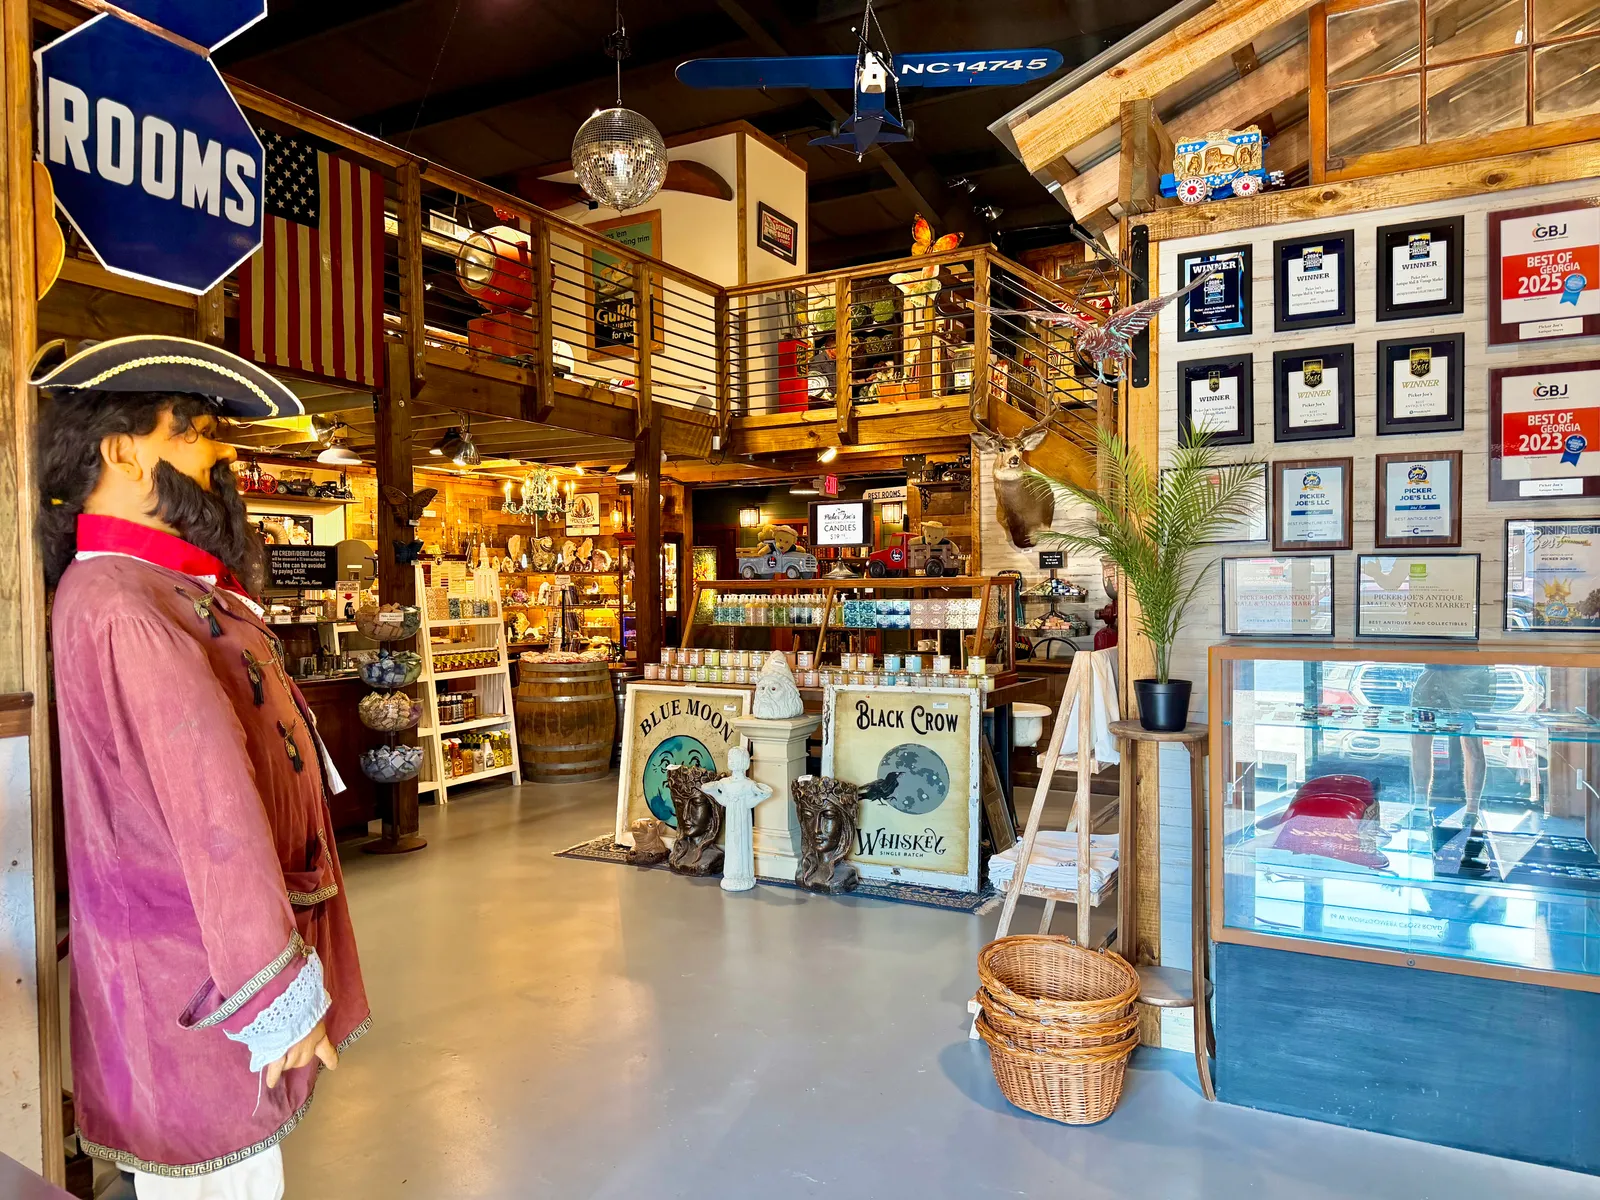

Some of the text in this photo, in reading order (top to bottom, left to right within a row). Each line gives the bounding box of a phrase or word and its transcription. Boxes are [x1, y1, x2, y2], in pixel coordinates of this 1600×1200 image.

[901, 58, 1048, 75] NC14745
[48, 77, 257, 227] ROOMS
[1533, 223, 1567, 239] GBJ
[637, 235, 650, 243] trim
[1402, 261, 1437, 270] WINNER
[1527, 252, 1573, 268] BEST OF
[1192, 261, 1236, 274] WINNER
[1540, 262, 1580, 274] GEORGIA
[1296, 273, 1330, 282] WINNER
[1518, 273, 1563, 294] 2025
[612, 330, 622, 339] for
[1402, 379, 1440, 389] WINNER
[1533, 383, 1568, 398] GBJ
[1199, 394, 1230, 402] WINNER
[1297, 389, 1331, 399] WINNER
[1527, 412, 1573, 426] BEST OF
[1540, 423, 1581, 433] GEORGIA
[1519, 433, 1563, 452] 2023
[867, 489, 901, 500] REST ROOMS
[824, 524, 857, 532] CANDLES
[1522, 530, 1569, 554] Best
[1435, 601, 1471, 609] MARKET
[639, 698, 734, 743] BLUE MOON
[855, 700, 958, 735] BLACK CROW
[854, 827, 947, 856] WHISKEY
